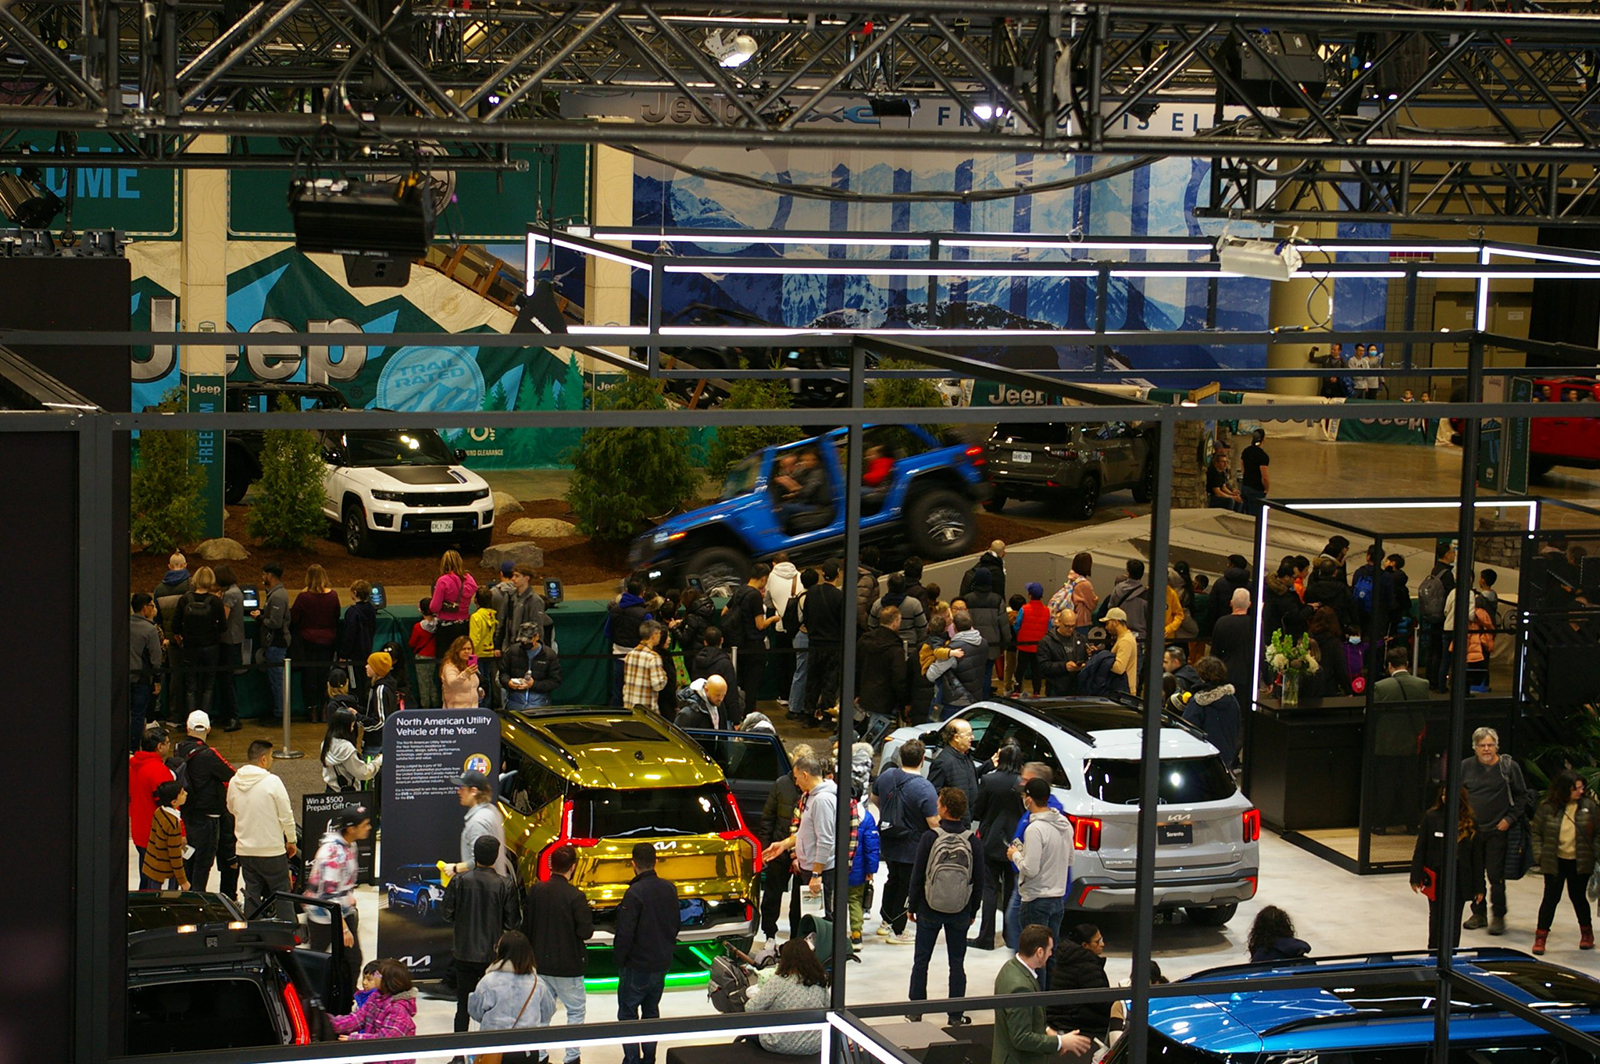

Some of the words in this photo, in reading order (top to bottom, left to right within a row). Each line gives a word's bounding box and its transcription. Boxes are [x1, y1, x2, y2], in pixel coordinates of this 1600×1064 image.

[397, 359, 459, 376] TRAIL
[394, 368, 464, 388] RATED
[192, 384, 221, 394] Jeep
[396, 718, 422, 726] North
[424, 717, 464, 725] American
[466, 716, 492, 725] Utility
[396, 728, 427, 736] Vehicle
[326, 795, 343, 804] $500
[306, 804, 331, 812] Prepaid
